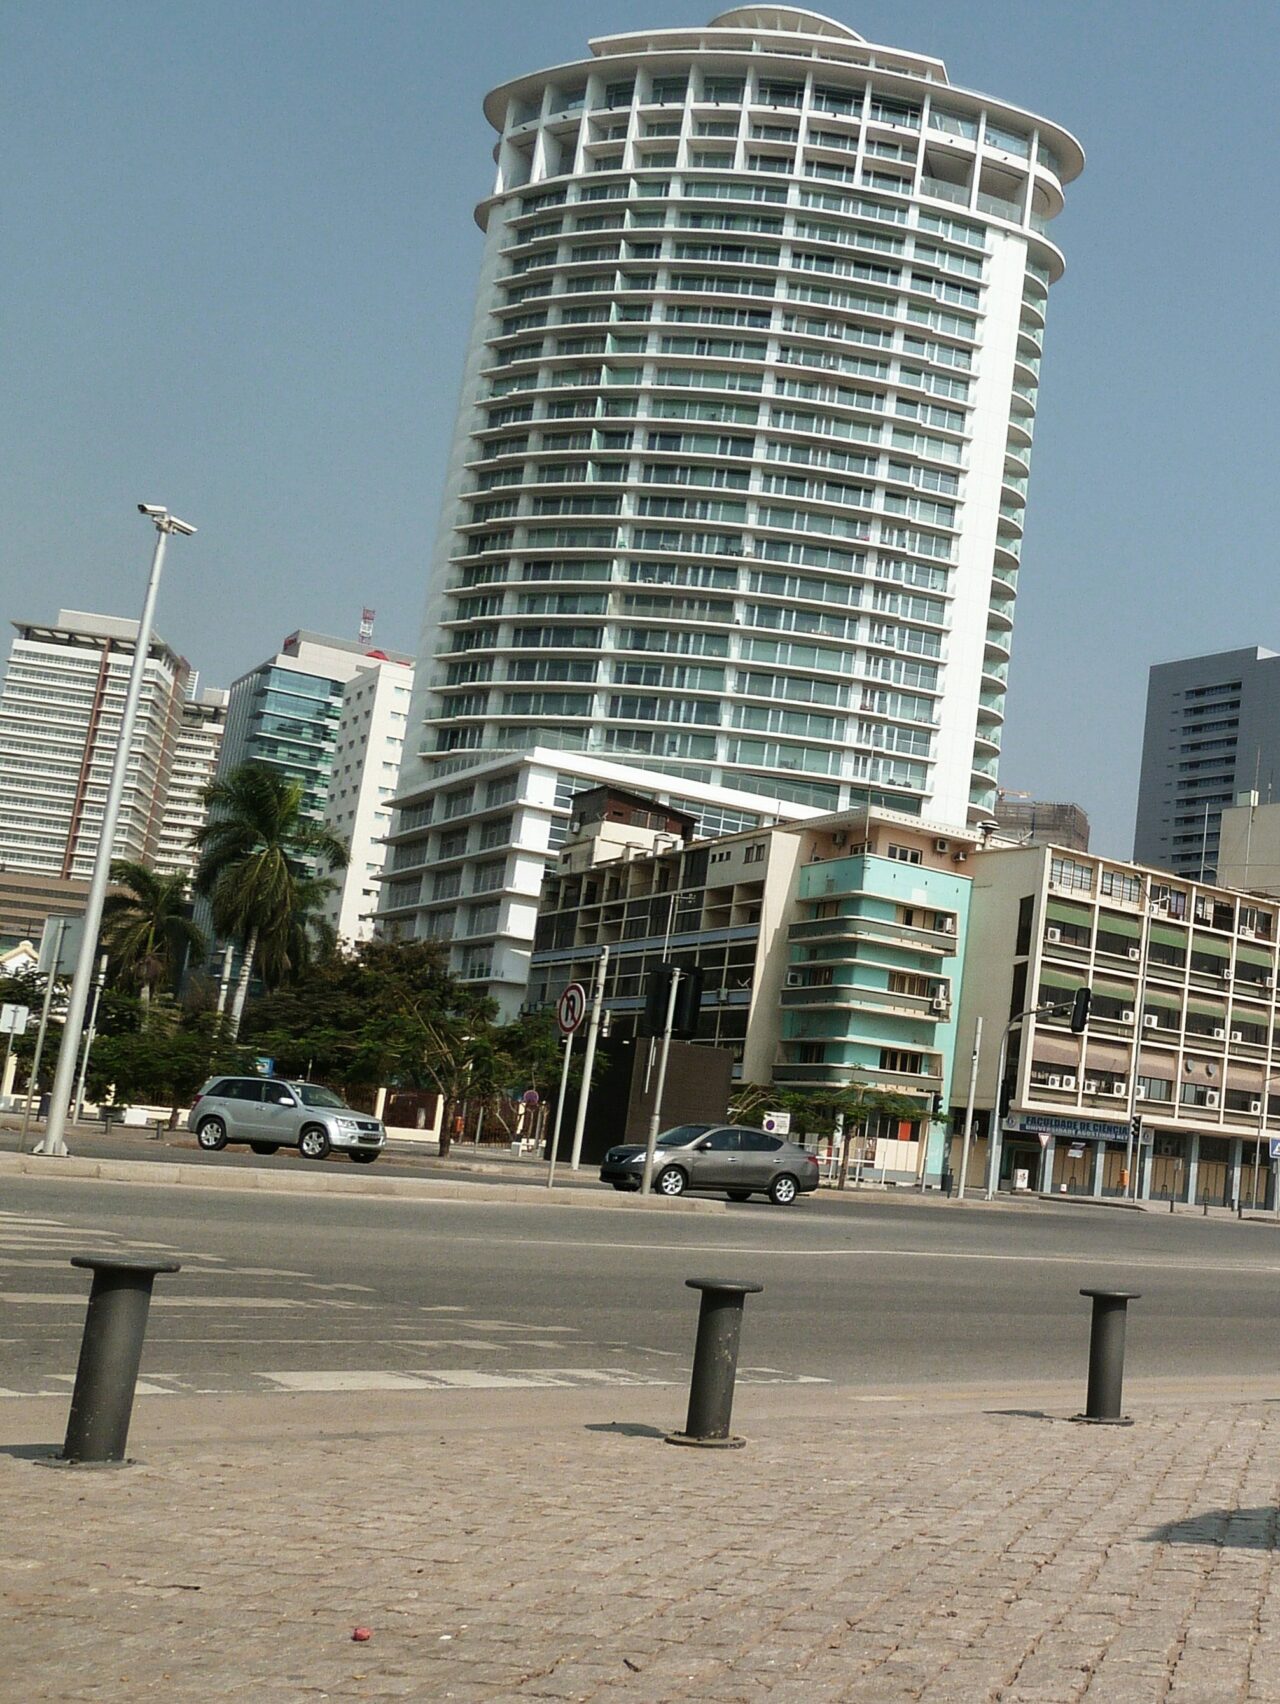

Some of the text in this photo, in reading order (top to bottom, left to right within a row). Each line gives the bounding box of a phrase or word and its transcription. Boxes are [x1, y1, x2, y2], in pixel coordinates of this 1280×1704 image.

[1025, 1116, 1079, 1130] FACULDADE
[1080, 1121, 1091, 1132] DE
[1026, 1124, 1075, 1135] UNIVERSIDADE
